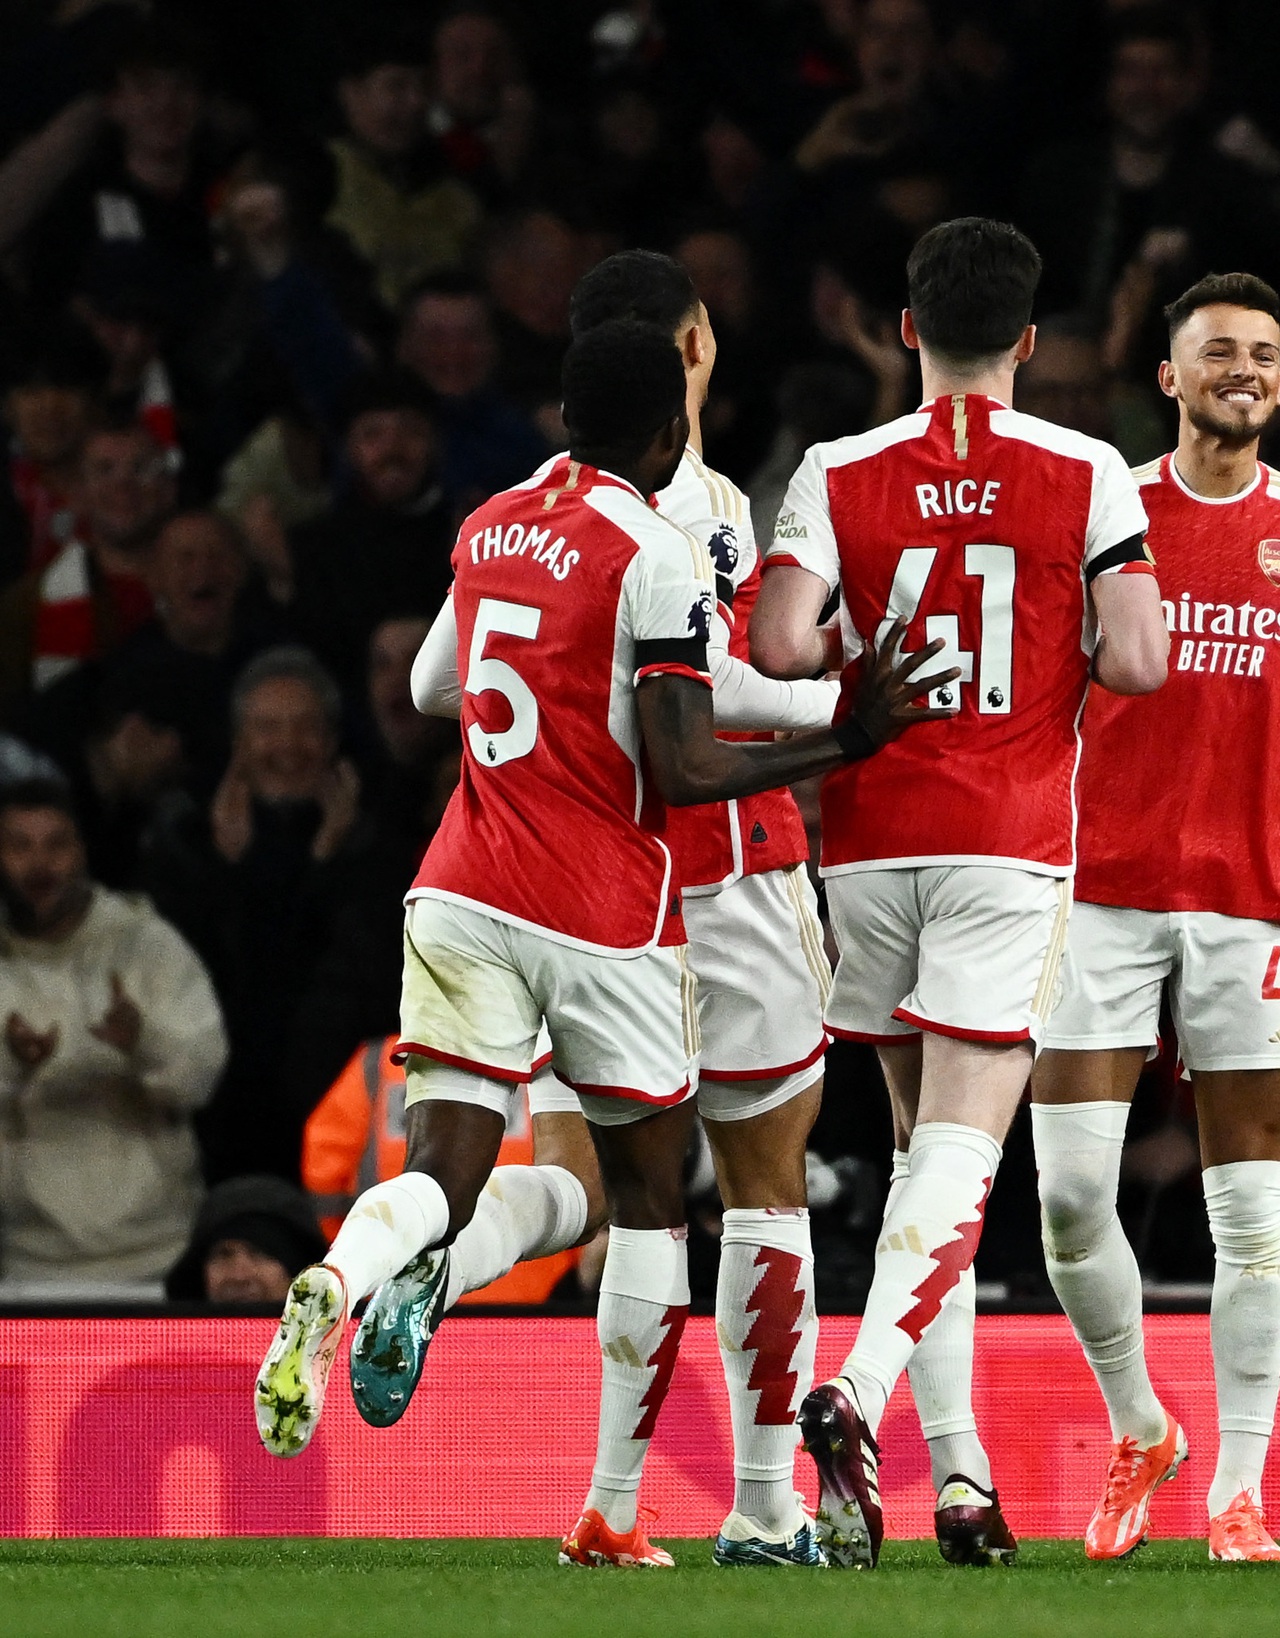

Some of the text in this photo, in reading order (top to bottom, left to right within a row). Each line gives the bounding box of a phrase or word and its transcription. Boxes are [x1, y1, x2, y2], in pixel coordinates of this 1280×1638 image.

[915, 479, 1001, 519] RICE
[469, 523, 580, 581] THOMAS
[774, 525, 808, 539] NDA
[874, 543, 1016, 714] 41
[464, 597, 542, 768] 5
[1177, 640, 1265, 677] BETTER
